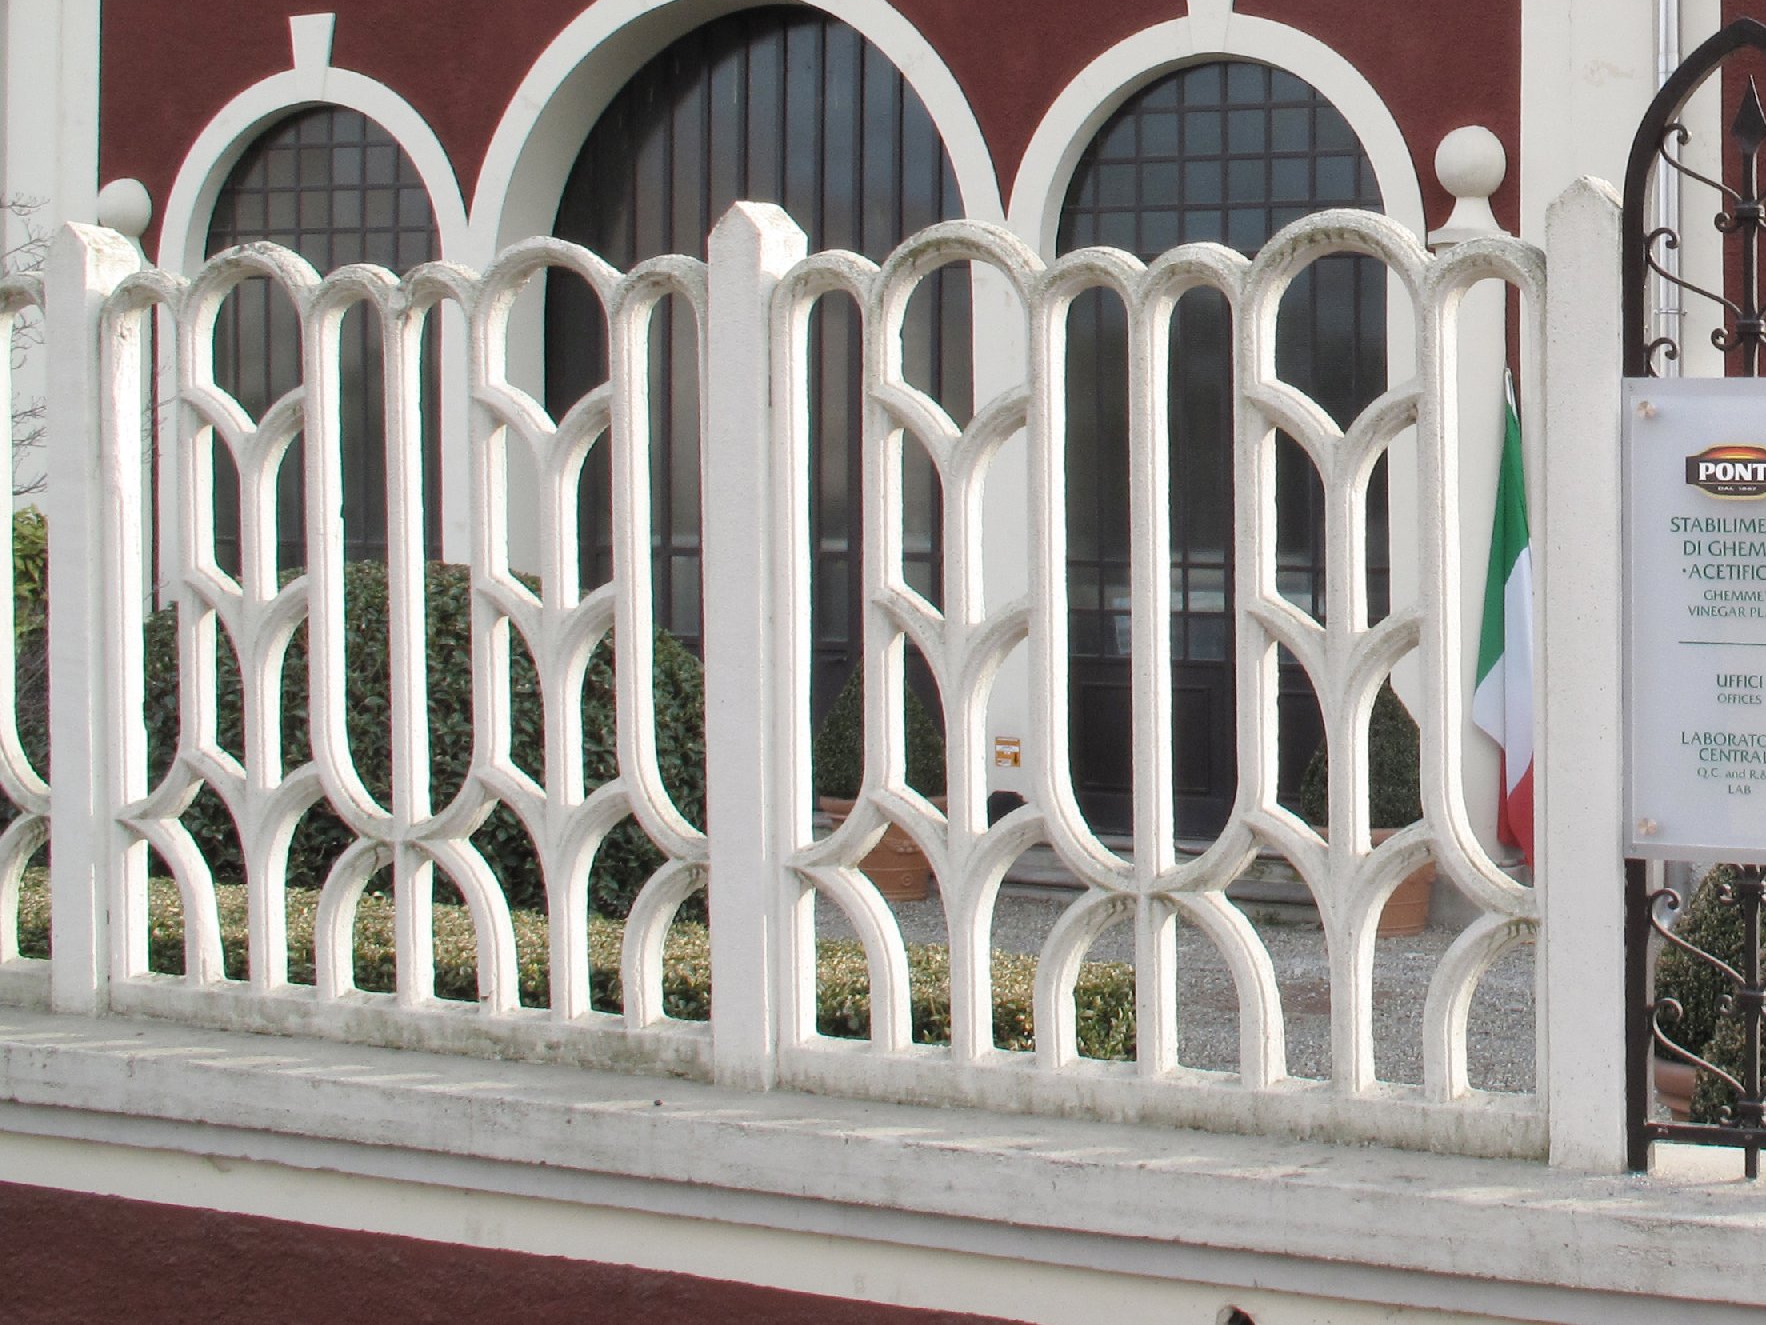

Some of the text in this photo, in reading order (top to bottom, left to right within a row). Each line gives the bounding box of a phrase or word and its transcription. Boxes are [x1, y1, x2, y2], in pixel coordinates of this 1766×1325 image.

[1683, 540, 1701, 556] DI
[1687, 606, 1746, 617] VINEGAR
[1716, 674, 1763, 689] UFFICI
[1717, 693, 1762, 705] OFFICES
[1725, 769, 1746, 779] and
[1728, 784, 1751, 794] LAB
